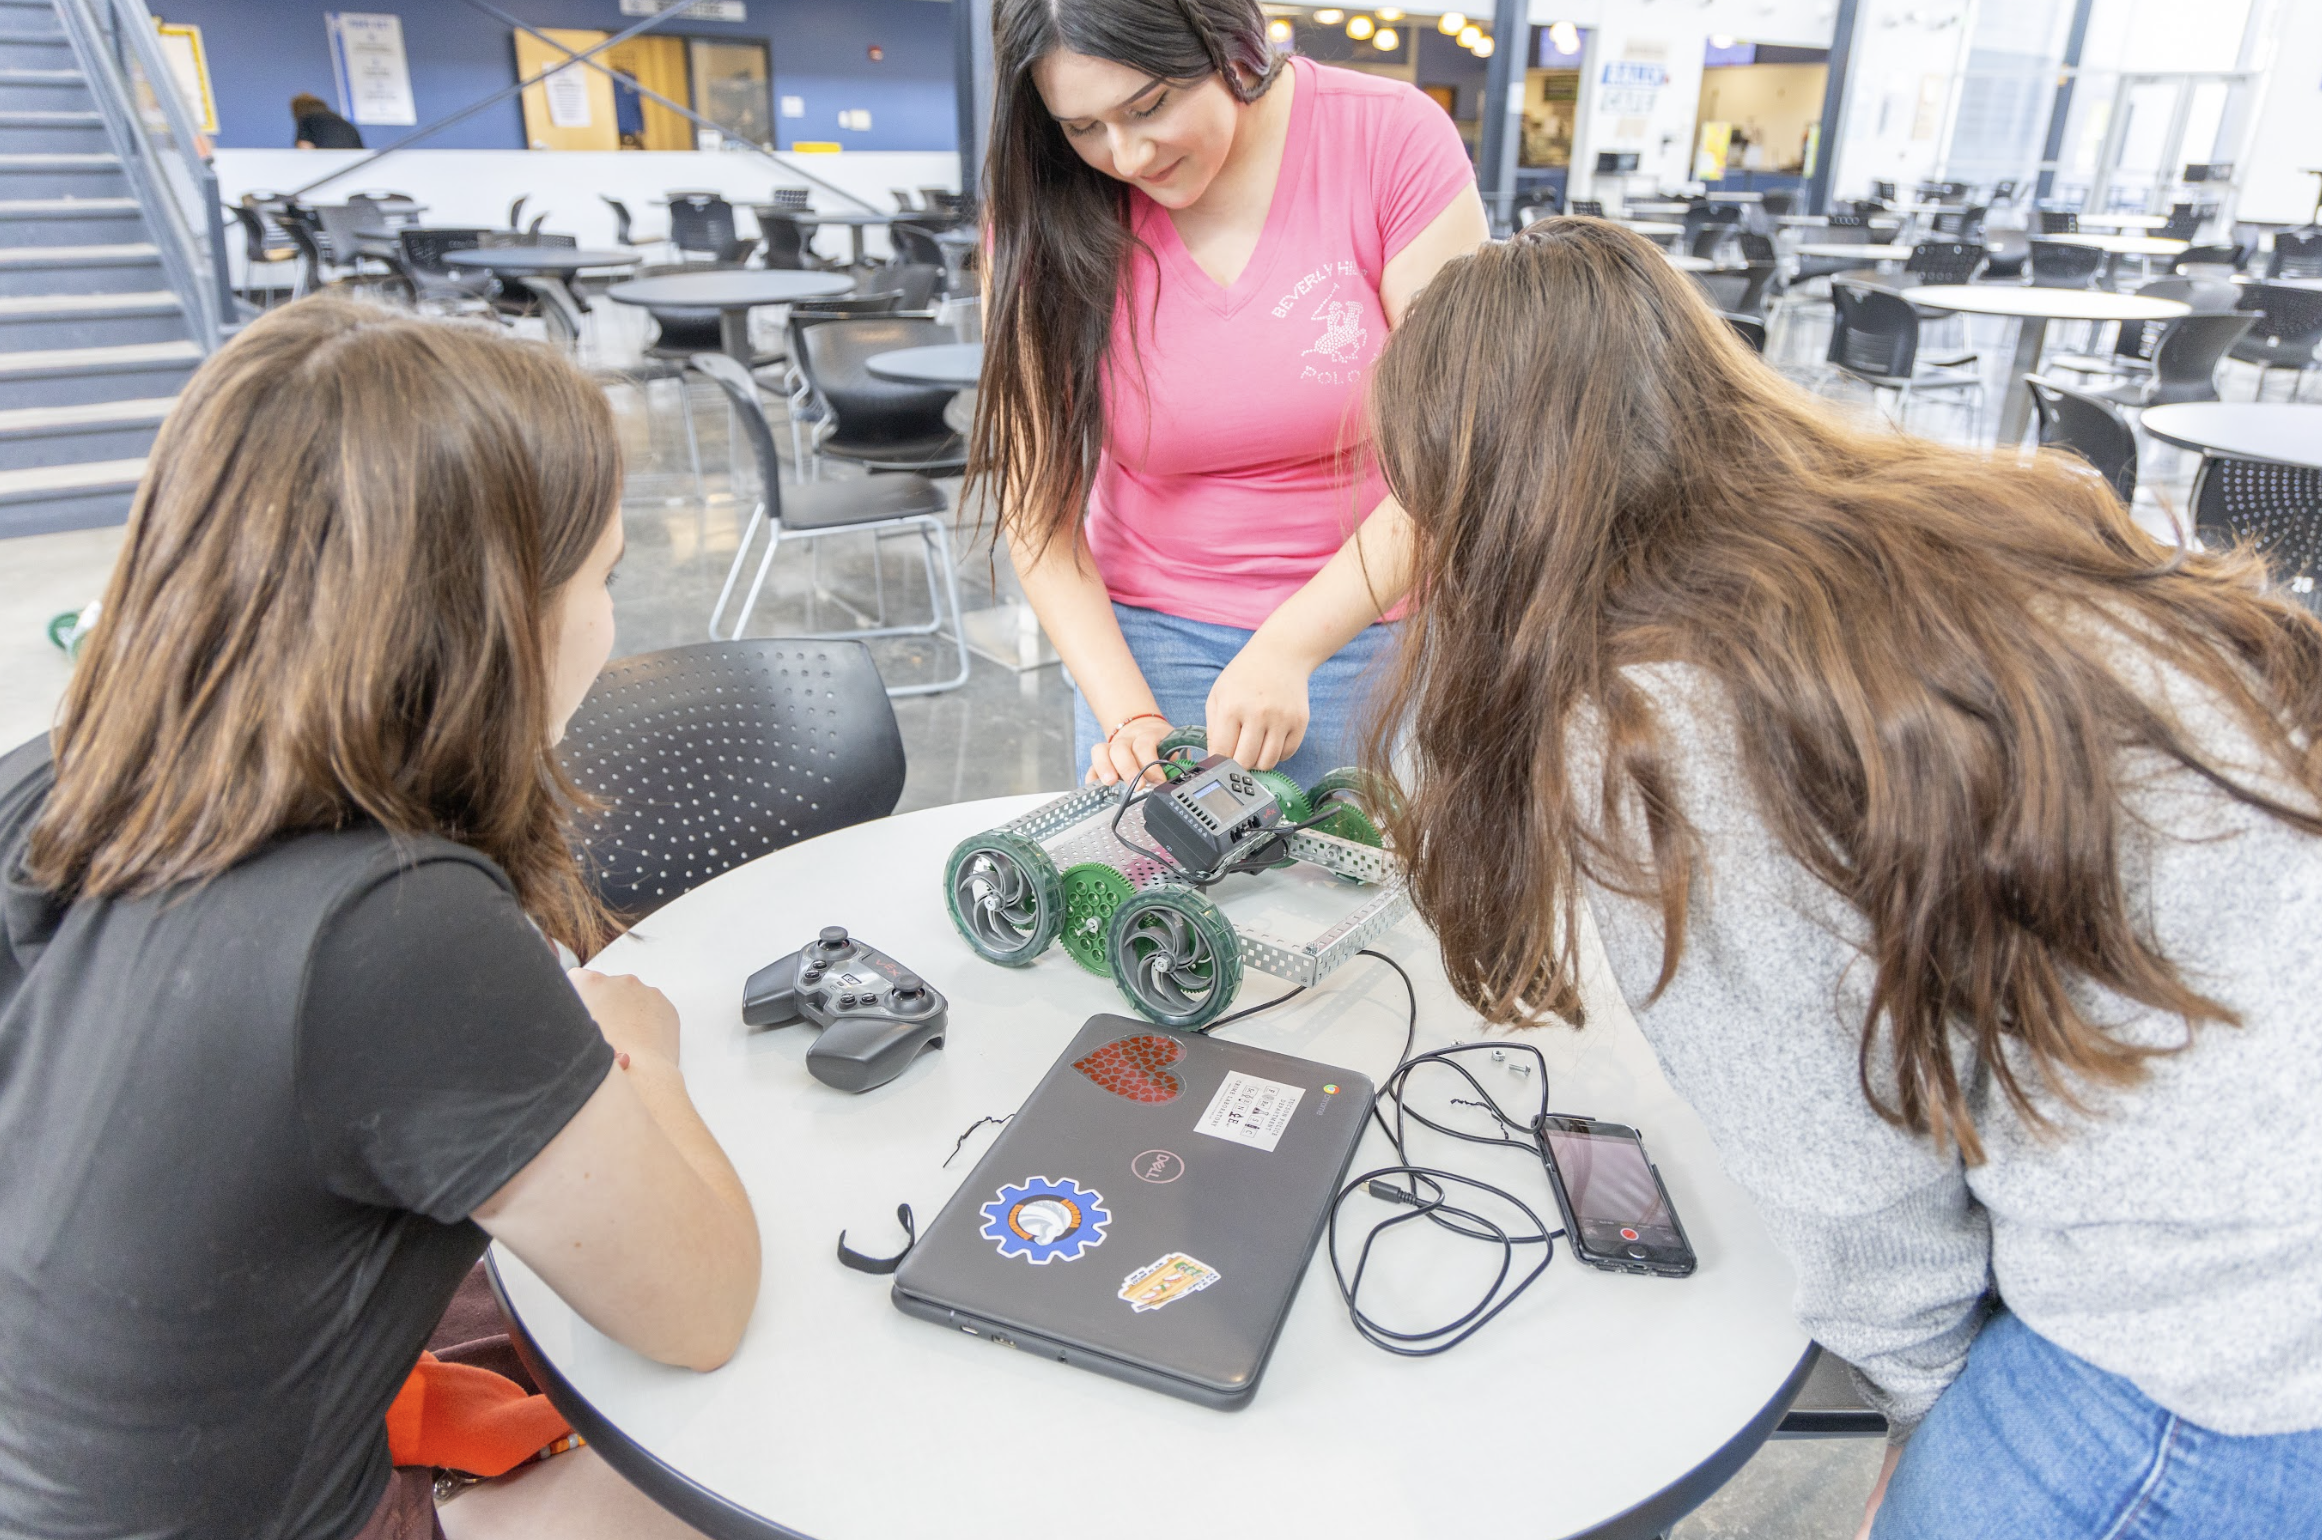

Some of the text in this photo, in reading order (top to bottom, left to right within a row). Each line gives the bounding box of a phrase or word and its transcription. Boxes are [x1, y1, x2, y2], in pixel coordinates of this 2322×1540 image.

[1271, 260, 1368, 319] BEVERLY HIL
[1300, 365, 1361, 385] POLO
[1228, 1079, 1242, 1095] CRIME
[1210, 1095, 1233, 1127] LABORATORY
[1265, 1098, 1286, 1131] DEPARTMENT
[1271, 1097, 1295, 1136] TUCSON POLICE
[1145, 1154, 1170, 1178] DELL
